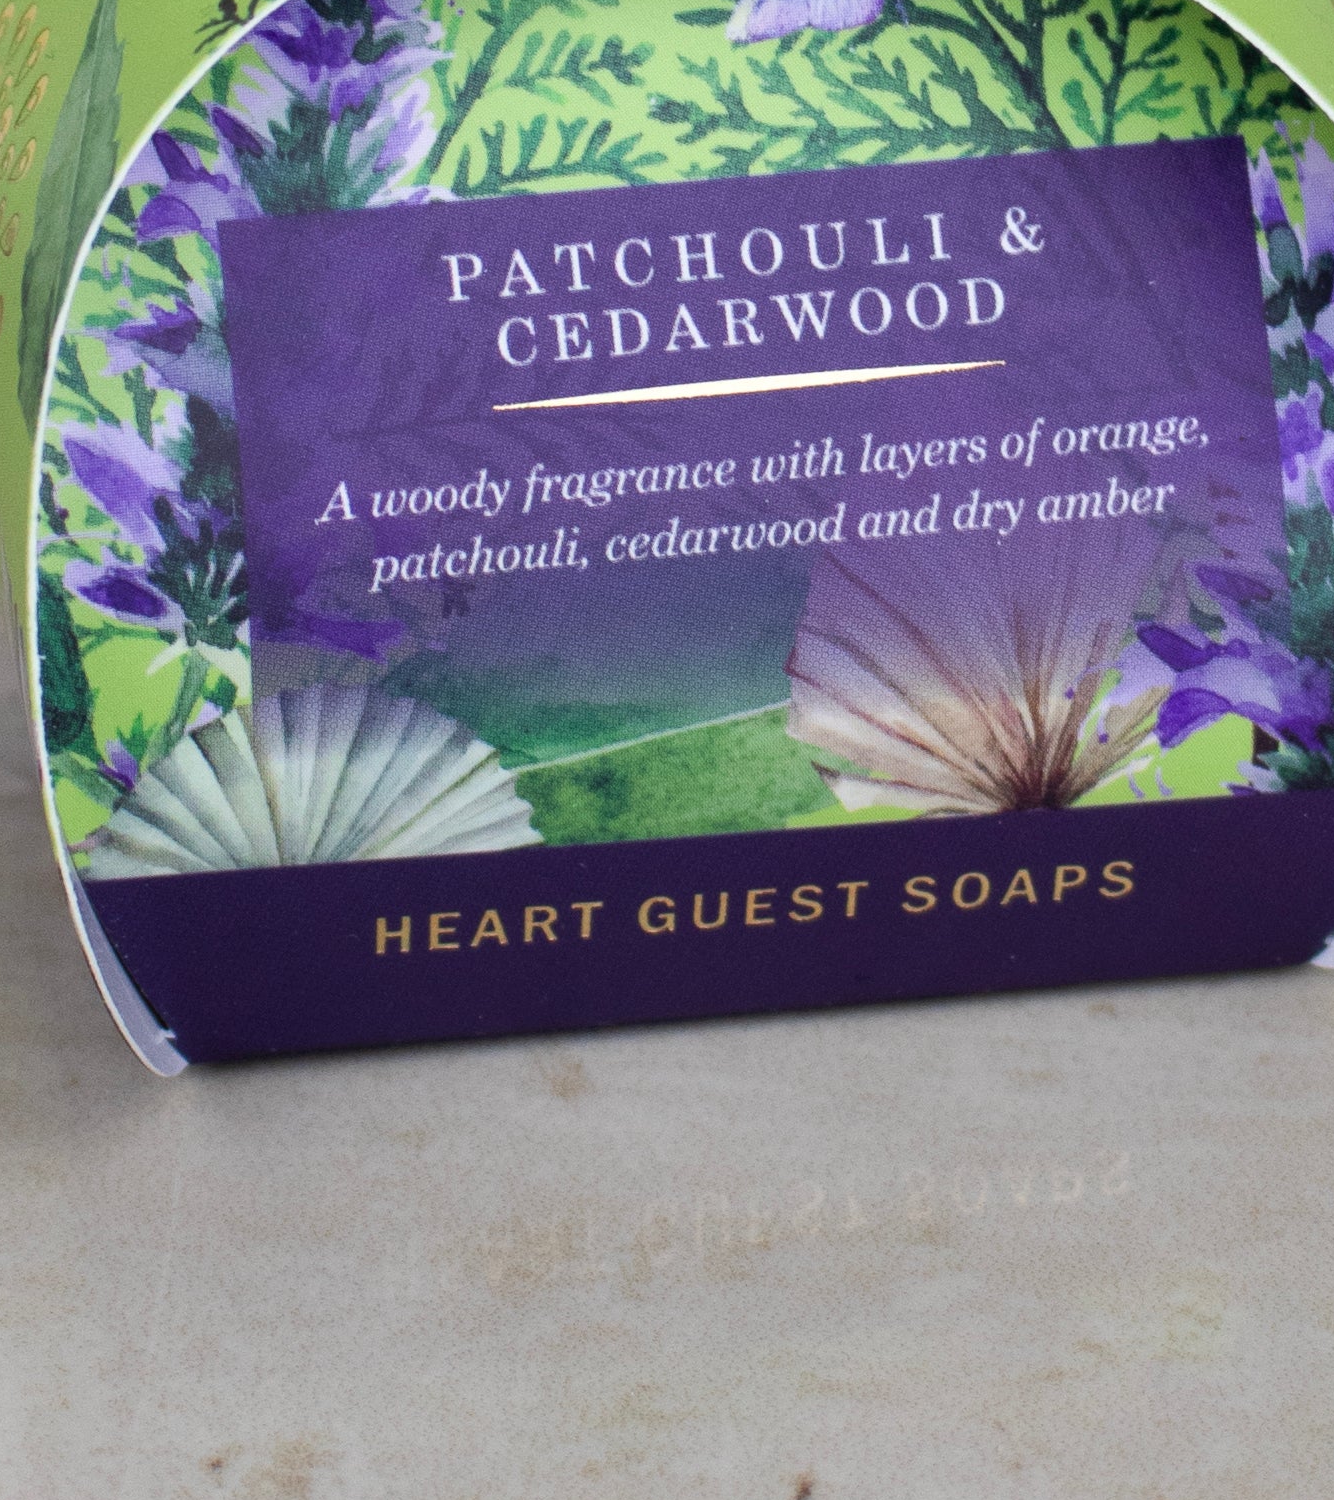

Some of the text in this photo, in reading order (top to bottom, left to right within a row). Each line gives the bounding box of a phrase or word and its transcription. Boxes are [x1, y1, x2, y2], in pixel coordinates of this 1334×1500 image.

[442, 208, 1043, 303] PATCHOULI &
[497, 276, 1006, 368] CEDARWOOD
[315, 417, 1208, 524] A woody fragrance with layers of orange,
[370, 477, 1175, 593] patchouli, cedarwood and dry amber
[376, 861, 1133, 954] HEART GUEST SOAPS
